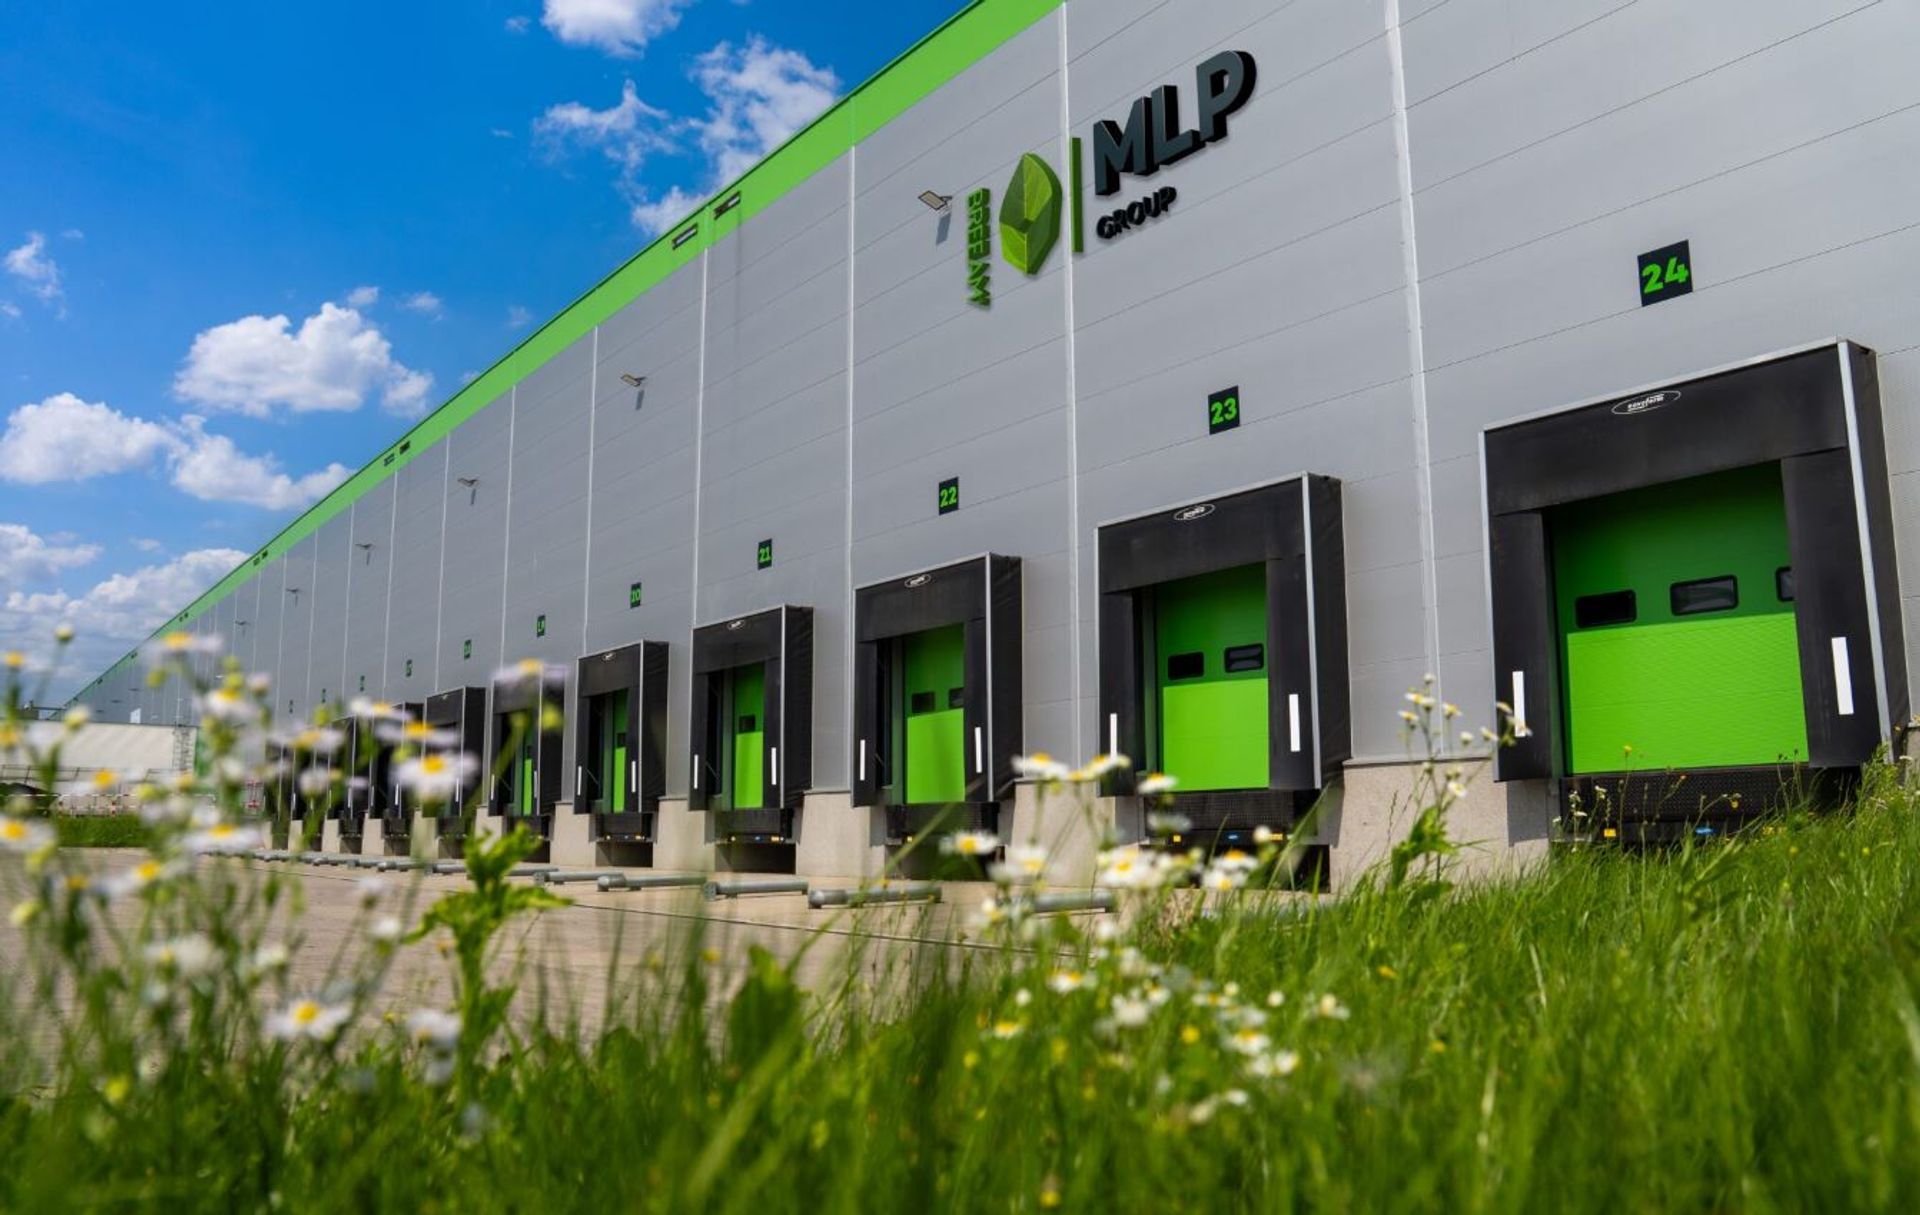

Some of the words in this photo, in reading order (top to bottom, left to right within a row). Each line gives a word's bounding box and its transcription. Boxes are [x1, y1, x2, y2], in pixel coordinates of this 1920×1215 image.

[1093, 50, 1257, 196] MLP
[1096, 186, 1178, 240] GROUP
[967, 187, 991, 309] BREEAM
[1642, 257, 1688, 293] 24
[1210, 397, 1237, 424] 23
[940, 486, 957, 507] 22
